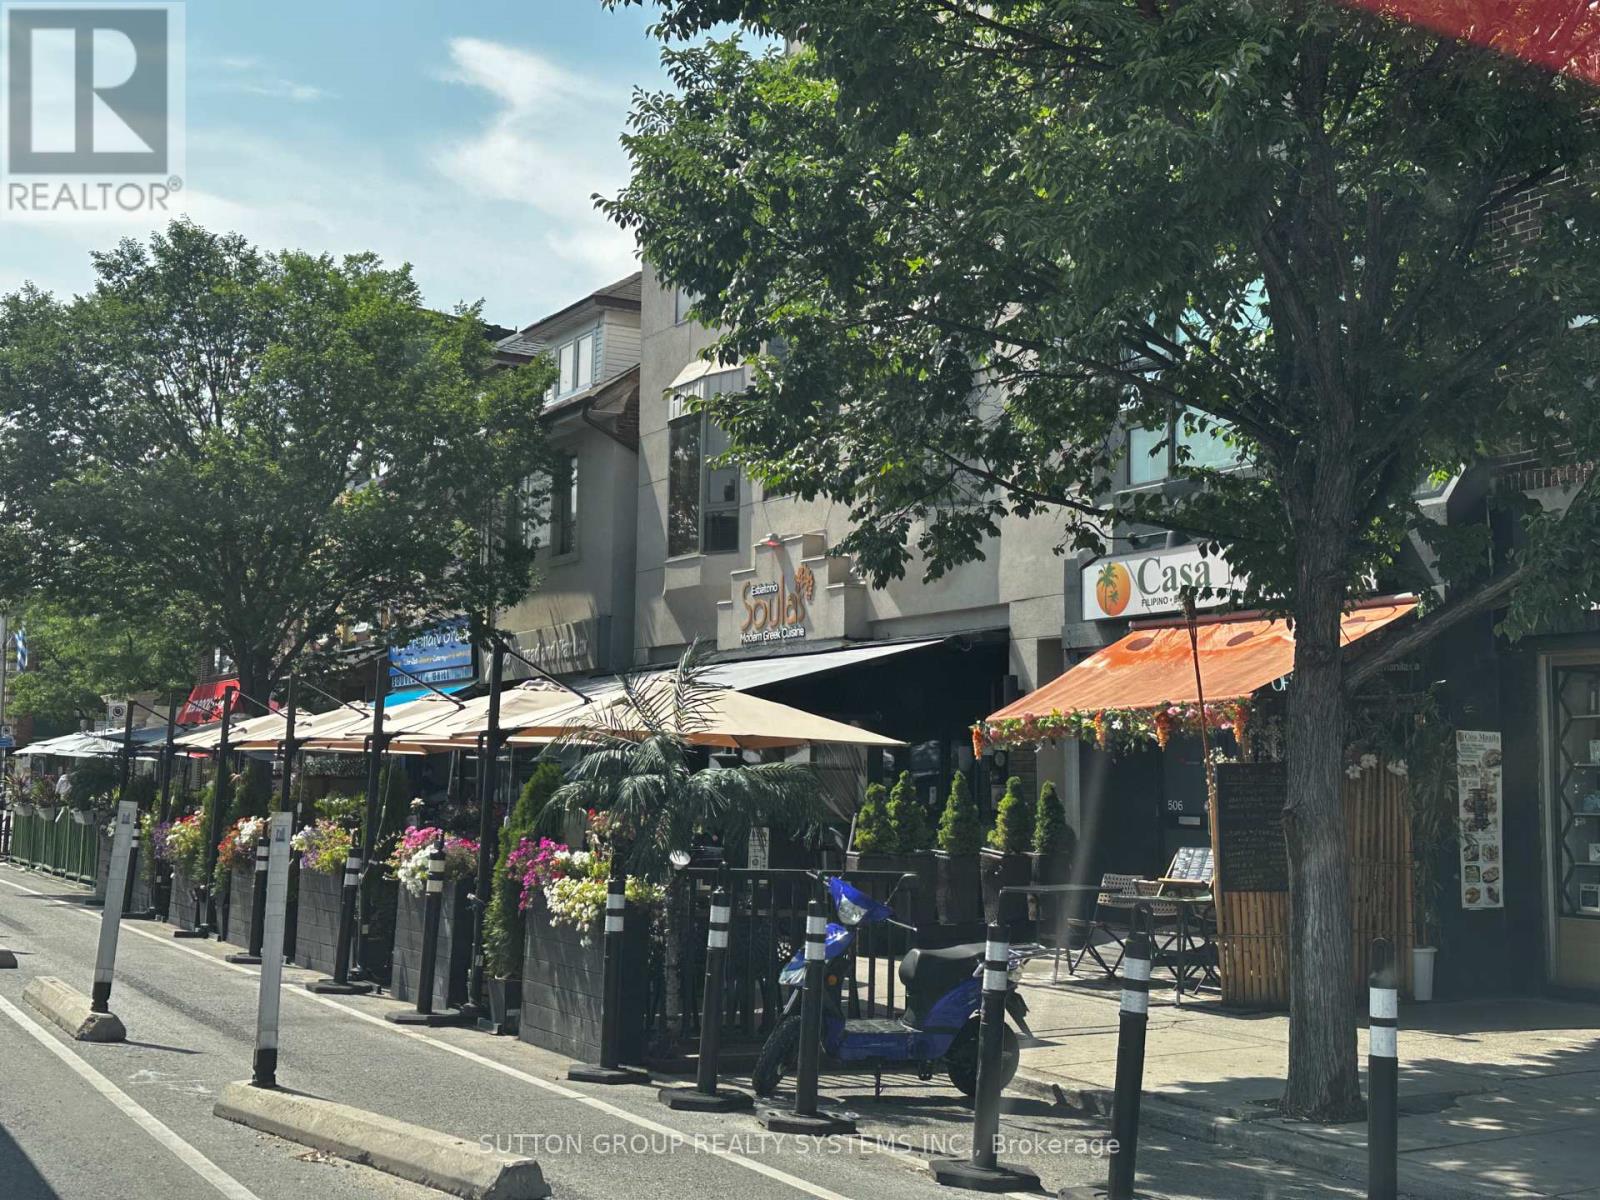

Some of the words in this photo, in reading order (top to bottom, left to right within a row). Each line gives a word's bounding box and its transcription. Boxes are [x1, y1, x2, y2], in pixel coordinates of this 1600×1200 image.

[1137, 557, 1211, 595] Casa
[1141, 596, 1169, 607] FILIPINO
[740, 632, 763, 643] Modern
[763, 628, 781, 640] Greek
[782, 626, 805, 639] Cuisine
[1167, 800, 1183, 811] 506
